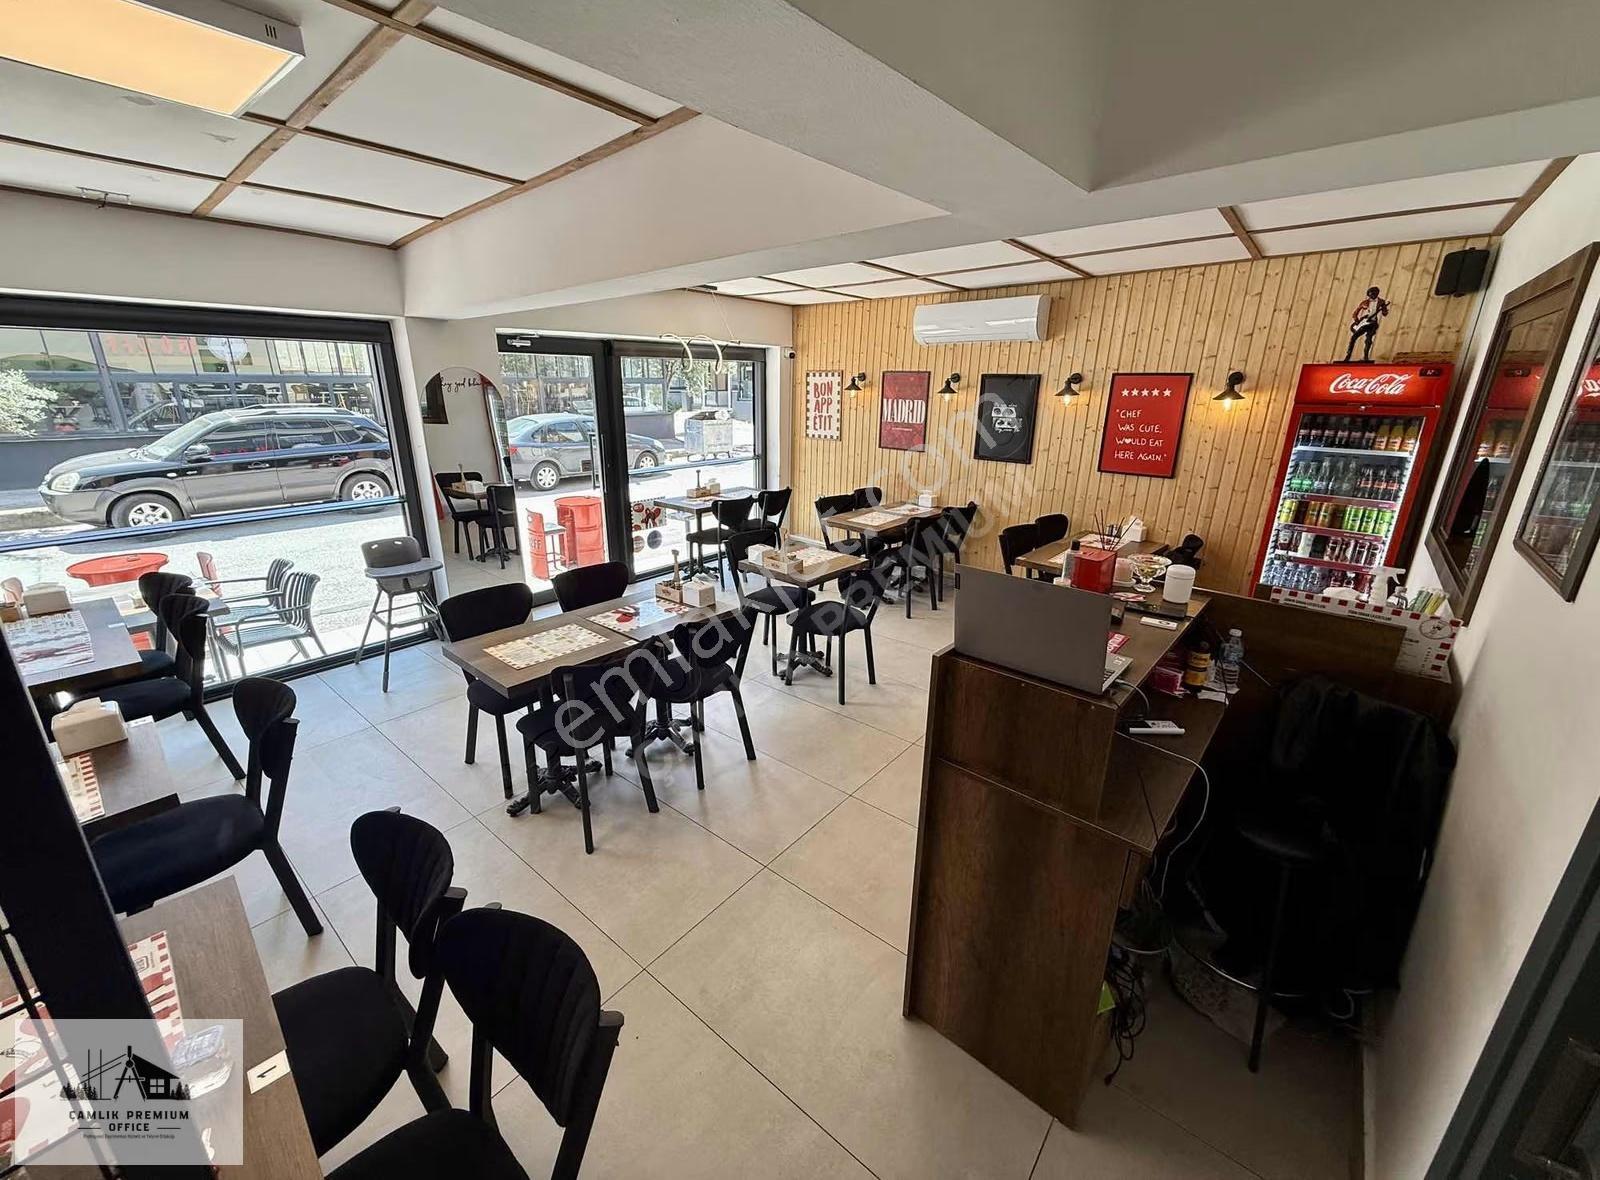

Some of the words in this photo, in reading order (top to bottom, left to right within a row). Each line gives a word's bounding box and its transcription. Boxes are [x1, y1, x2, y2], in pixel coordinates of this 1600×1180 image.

[813, 381, 833, 399] BON
[814, 397, 833, 414] APP
[882, 398, 926, 423] MADRID
[1118, 423, 1135, 432] WAS
[1149, 439, 1164, 447] EAT
[1114, 450, 1135, 460] HERE
